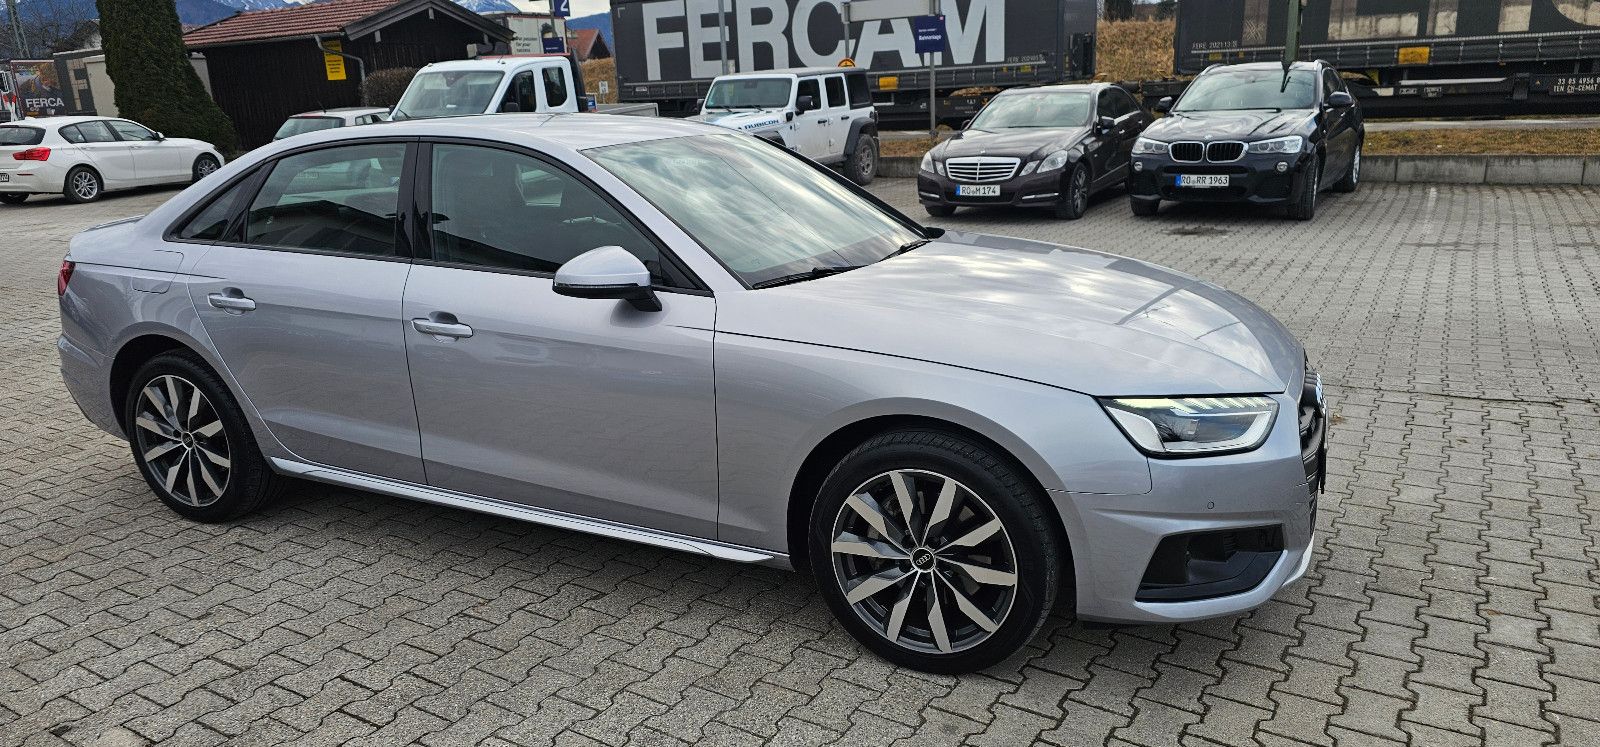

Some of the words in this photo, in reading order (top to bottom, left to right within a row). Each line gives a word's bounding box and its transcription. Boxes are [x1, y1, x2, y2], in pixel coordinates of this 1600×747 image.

[560, 0, 569, 12] 2
[642, 0, 1004, 82] FERCAM
[25, 97, 65, 108] FERCA
[744, 119, 779, 130] RUBICON
[1181, 176, 1191, 185] RO
[1196, 176, 1207, 185] RR
[1209, 176, 1228, 185] 1963
[961, 186, 971, 195] RO
[982, 186, 996, 195] 174
